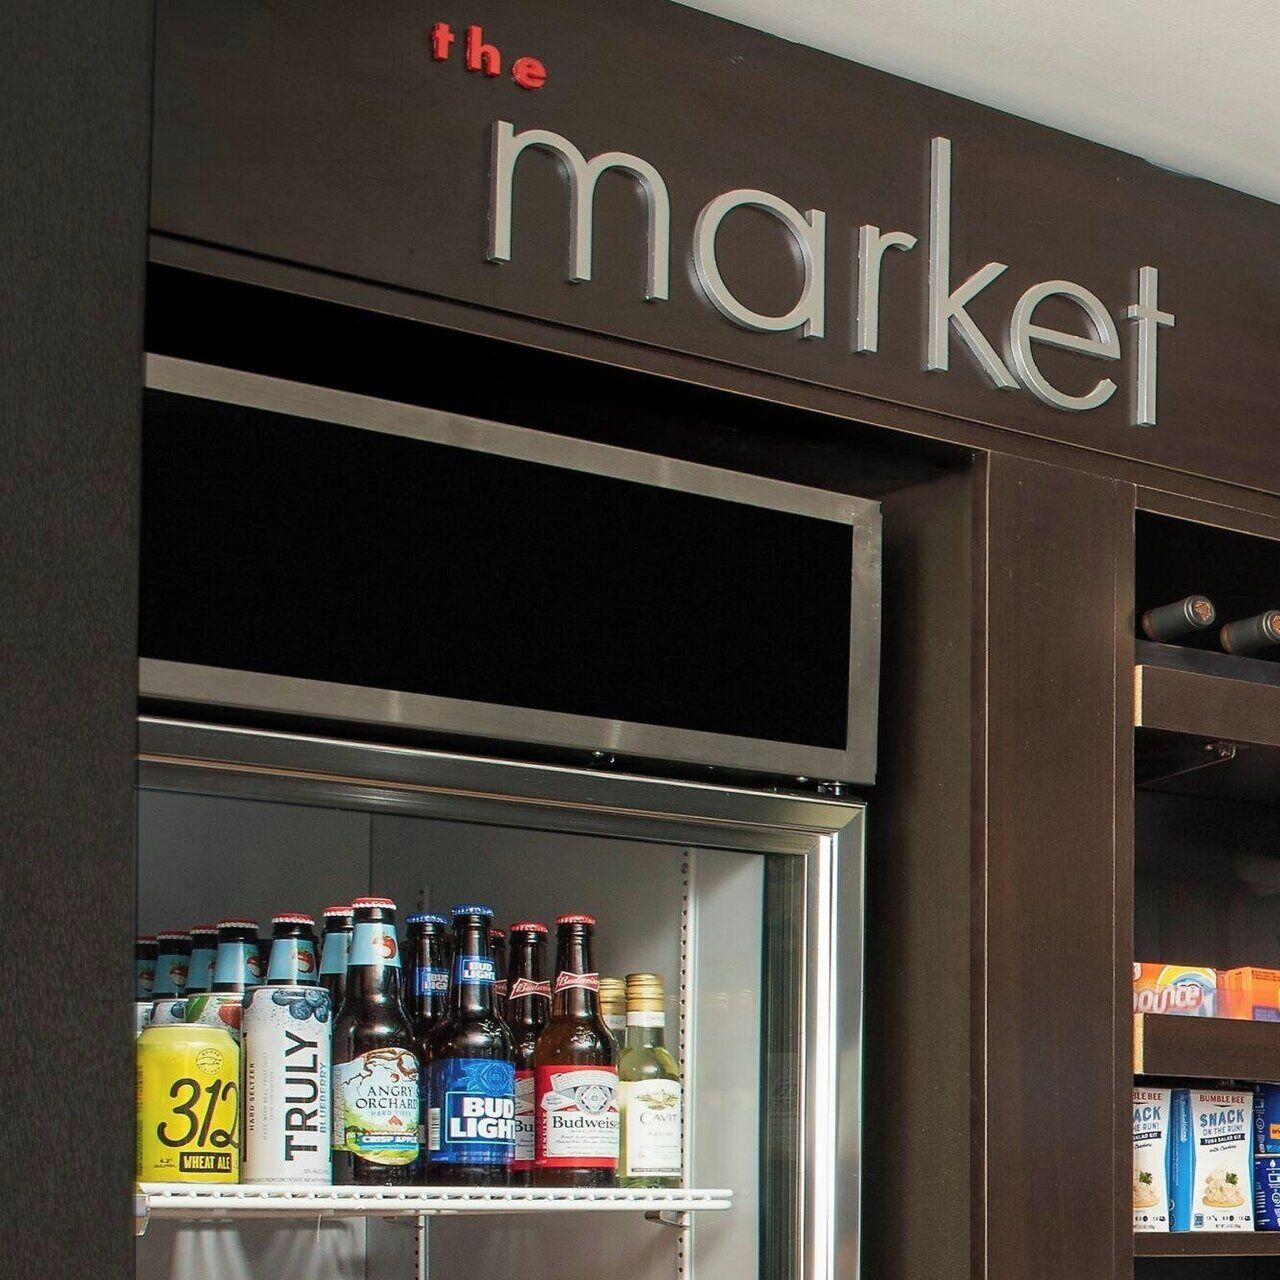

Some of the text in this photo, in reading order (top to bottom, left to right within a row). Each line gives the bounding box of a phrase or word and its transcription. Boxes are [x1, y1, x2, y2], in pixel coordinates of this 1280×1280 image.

[431, 22, 548, 90] the
[485, 119, 1176, 428] market
[1134, 982, 1202, 1014] ounce
[285, 1030, 319, 1162] TRULY
[367, 1085, 413, 1098] ANGRY
[1149, 1092, 1163, 1100] BEE
[1200, 1095, 1245, 1104] BUMBLE BEE
[355, 1097, 419, 1110] ORCHARD
[463, 1096, 515, 1117] BUD
[157, 1078, 240, 1150] 312
[1200, 1108, 1245, 1127] SNACK
[361, 1136, 393, 1145] CRISP
[183, 1155, 231, 1170] WHEAT ALE
